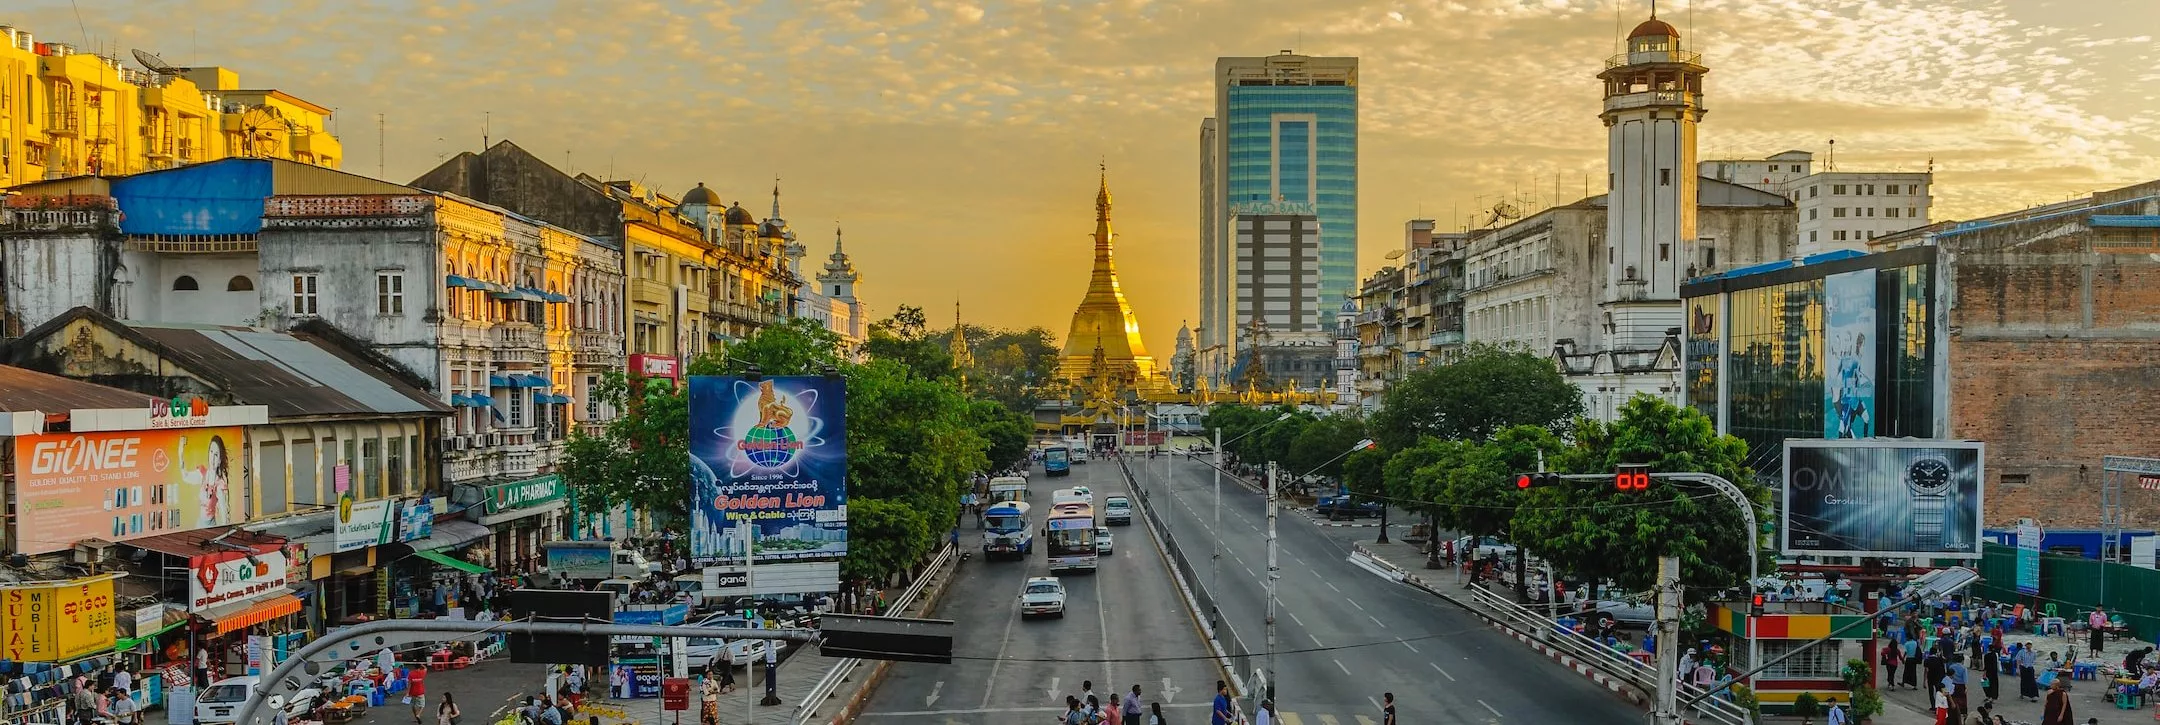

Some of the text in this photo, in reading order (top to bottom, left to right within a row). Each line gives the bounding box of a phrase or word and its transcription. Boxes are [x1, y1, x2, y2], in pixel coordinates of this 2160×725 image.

[1280, 202, 1314, 214] BANK
[150, 397, 168, 418] Do
[191, 396, 209, 417] Mo
[152, 419, 162, 428] Sale
[170, 418, 188, 427] Service
[191, 417, 206, 426] Center
[30, 471, 140, 488] GOLDEN QUALITY TO STAND LONG
[520, 479, 557, 502] PHARMACY
[714, 492, 825, 510] Golden Lion
[726, 511, 748, 520] Wire
[749, 512, 757, 520] &
[758, 510, 785, 519] Cable
[9, 589, 24, 660] SULAY
[31, 592, 41, 654] MOBILE
